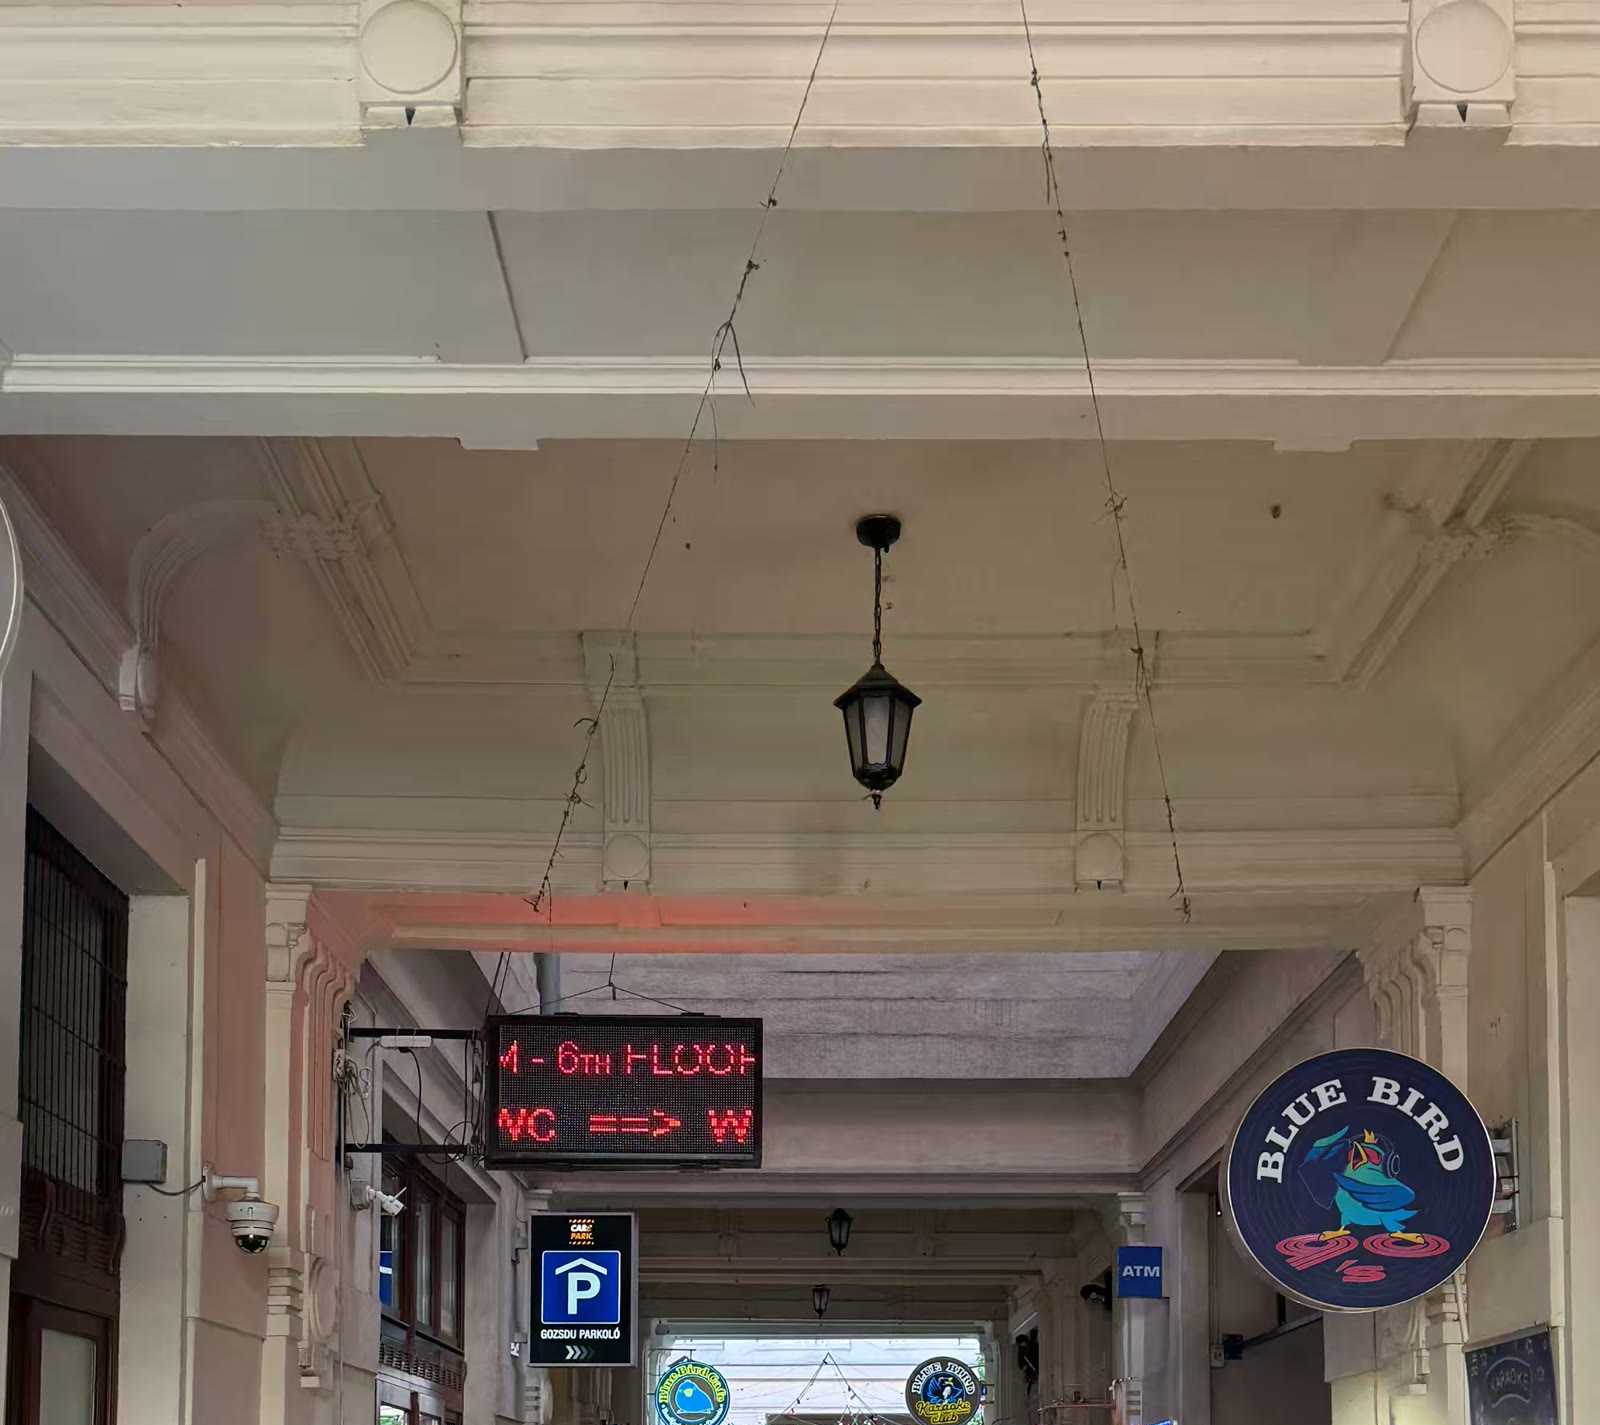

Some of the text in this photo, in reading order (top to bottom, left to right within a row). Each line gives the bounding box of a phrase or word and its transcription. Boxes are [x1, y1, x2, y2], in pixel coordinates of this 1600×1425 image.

[498, 1109, 556, 1142] WC
[1256, 1076, 1464, 1184] BLUE BIRD
[1122, 1265, 1160, 1277] ATM
[567, 1271, 601, 1315] P
[540, 1327, 621, 1339] GOZSDU PARKOLÓ
[658, 1372, 678, 1403] Blue
[675, 1363, 710, 1377] Bird
[911, 1362, 976, 1395] BLUE BIRD
[1490, 1367, 1529, 1391] KARAOKE
[915, 1398, 971, 1416] Karaoke
